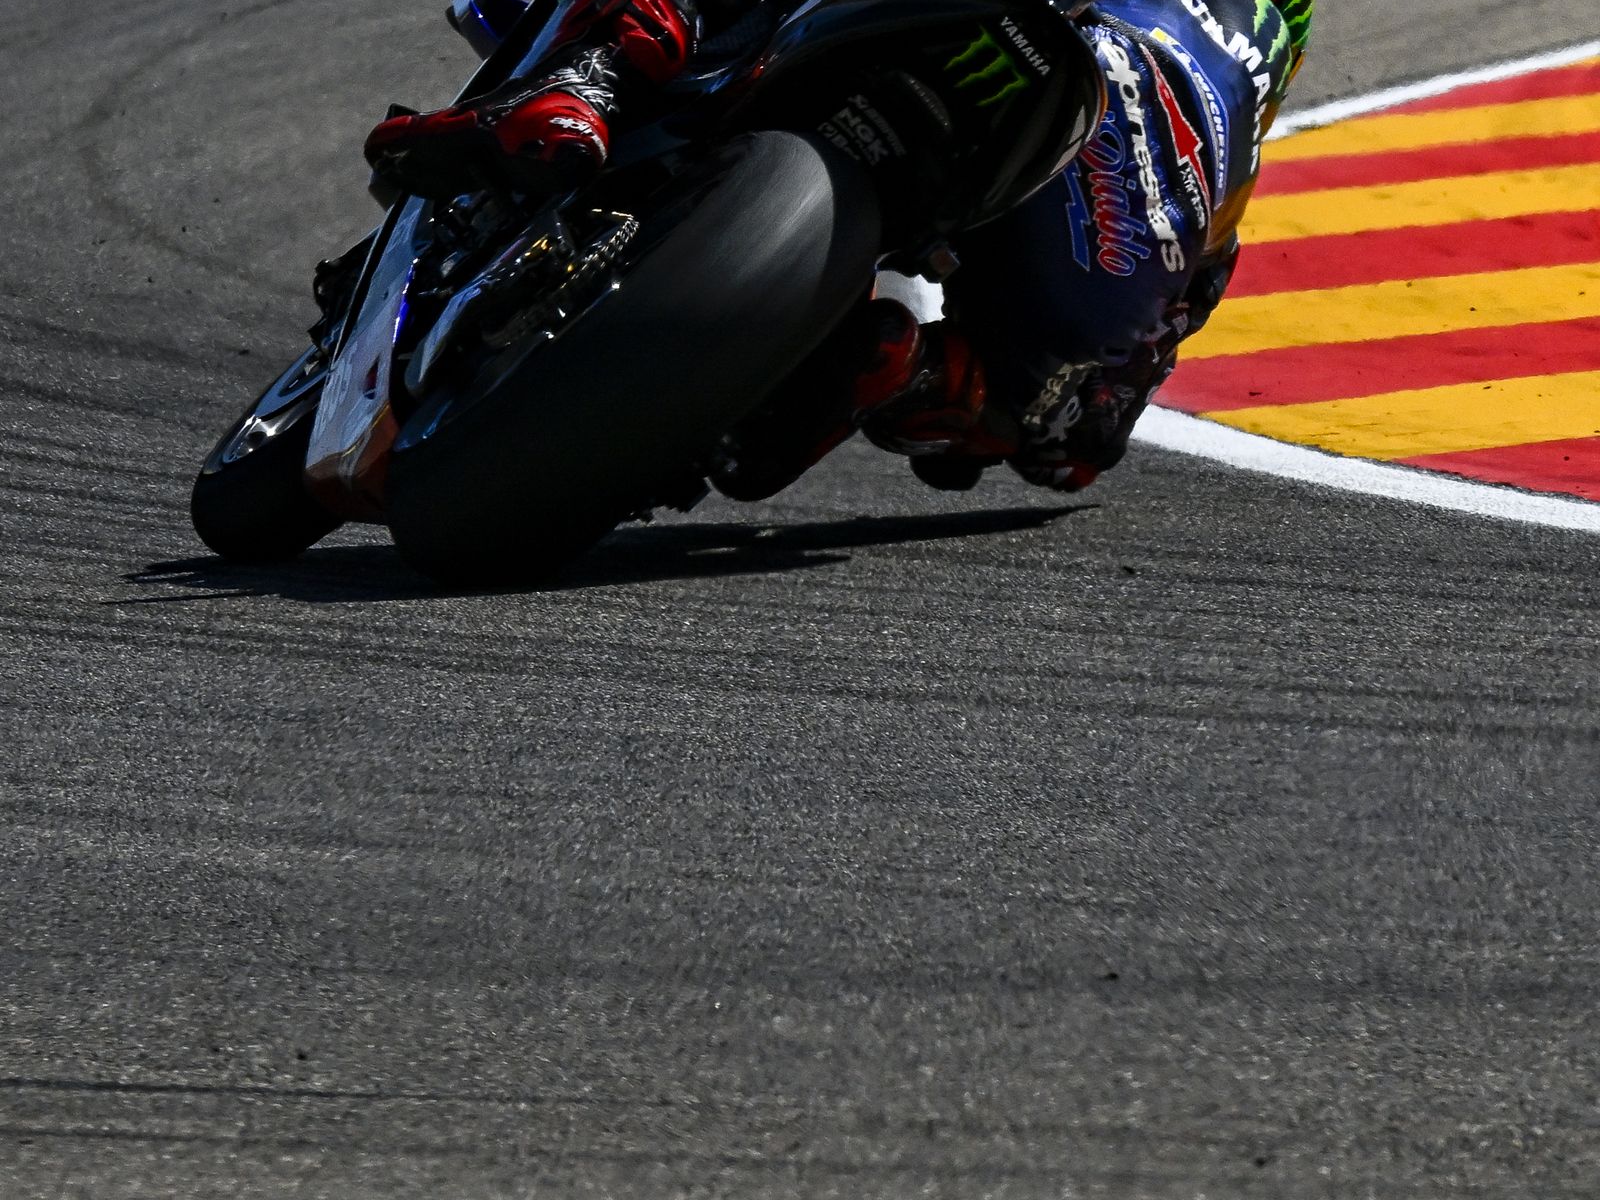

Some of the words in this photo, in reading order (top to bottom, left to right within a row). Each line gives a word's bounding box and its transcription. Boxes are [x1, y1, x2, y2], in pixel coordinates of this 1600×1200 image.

[1000, 16, 1052, 77] YAMAHA
[834, 105, 889, 163] NGK
[1078, 124, 1152, 277] Diablo
